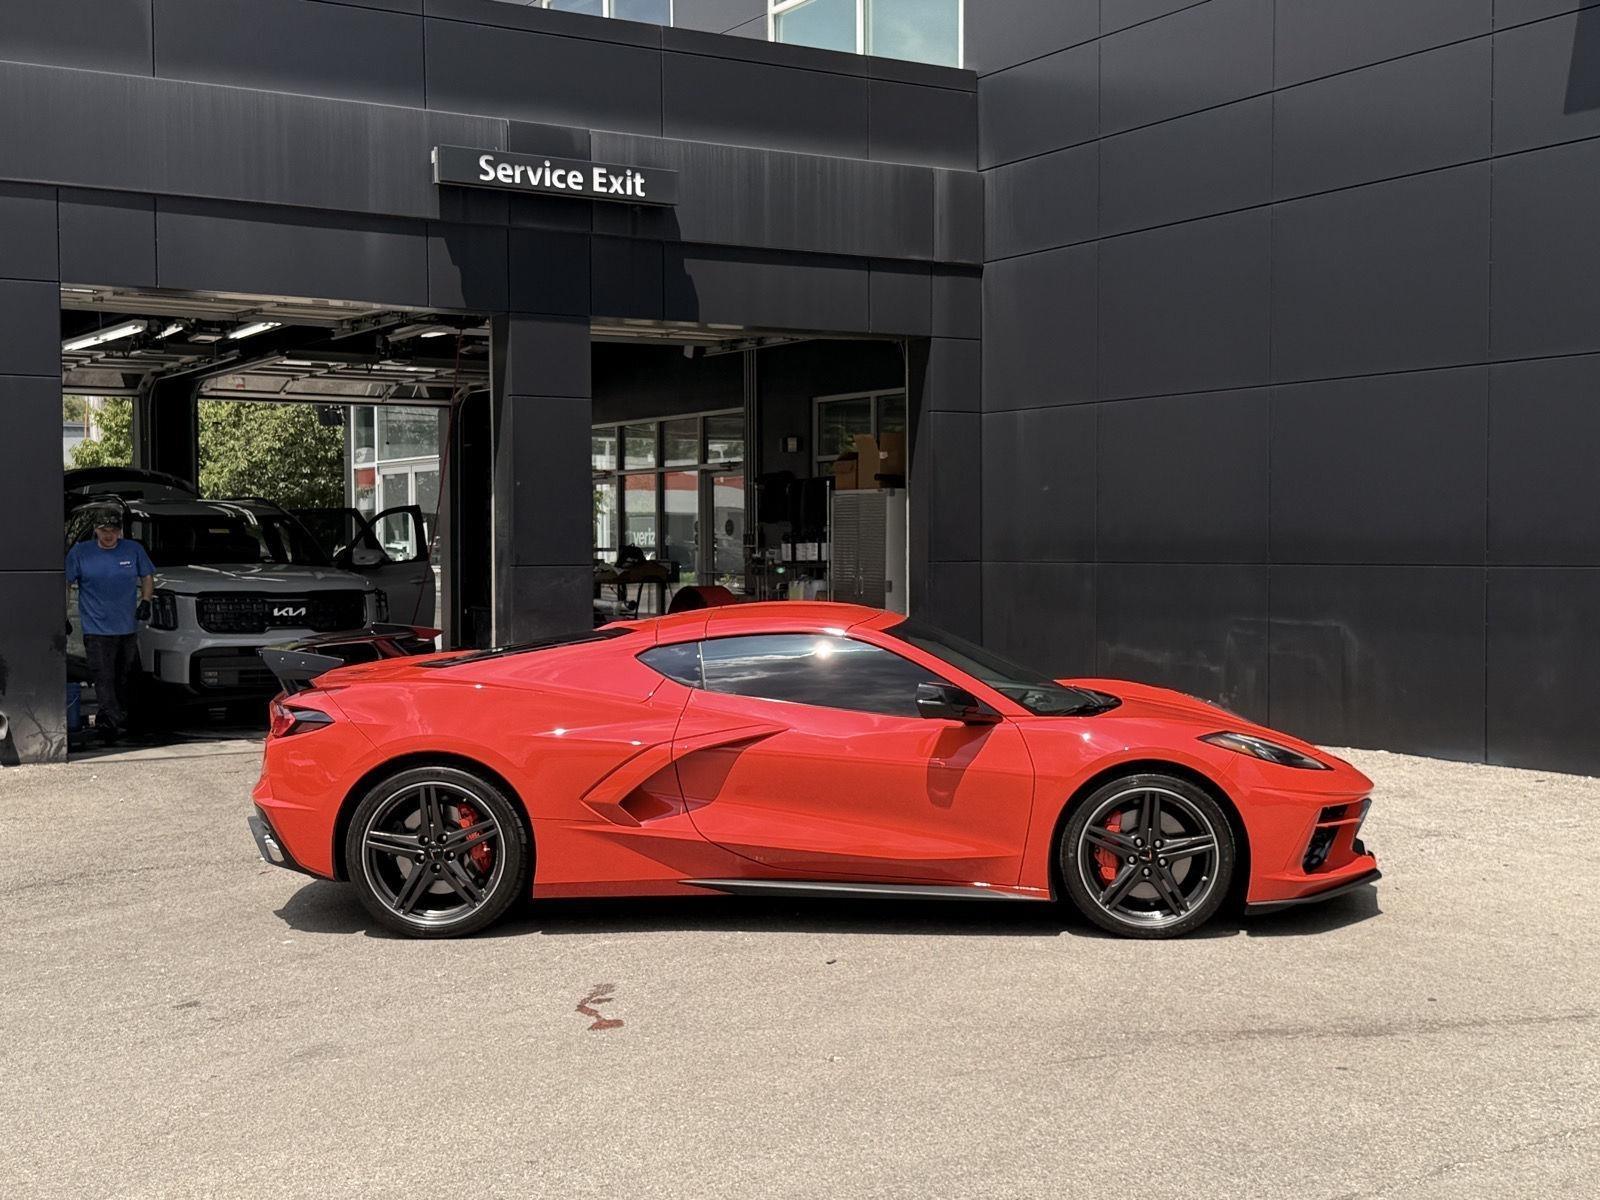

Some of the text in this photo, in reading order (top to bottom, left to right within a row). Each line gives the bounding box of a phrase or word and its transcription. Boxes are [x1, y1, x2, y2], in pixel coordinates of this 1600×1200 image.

[478, 154, 646, 198] Service Exit
[633, 527, 656, 546] veriz
[273, 607, 307, 617] KIA
